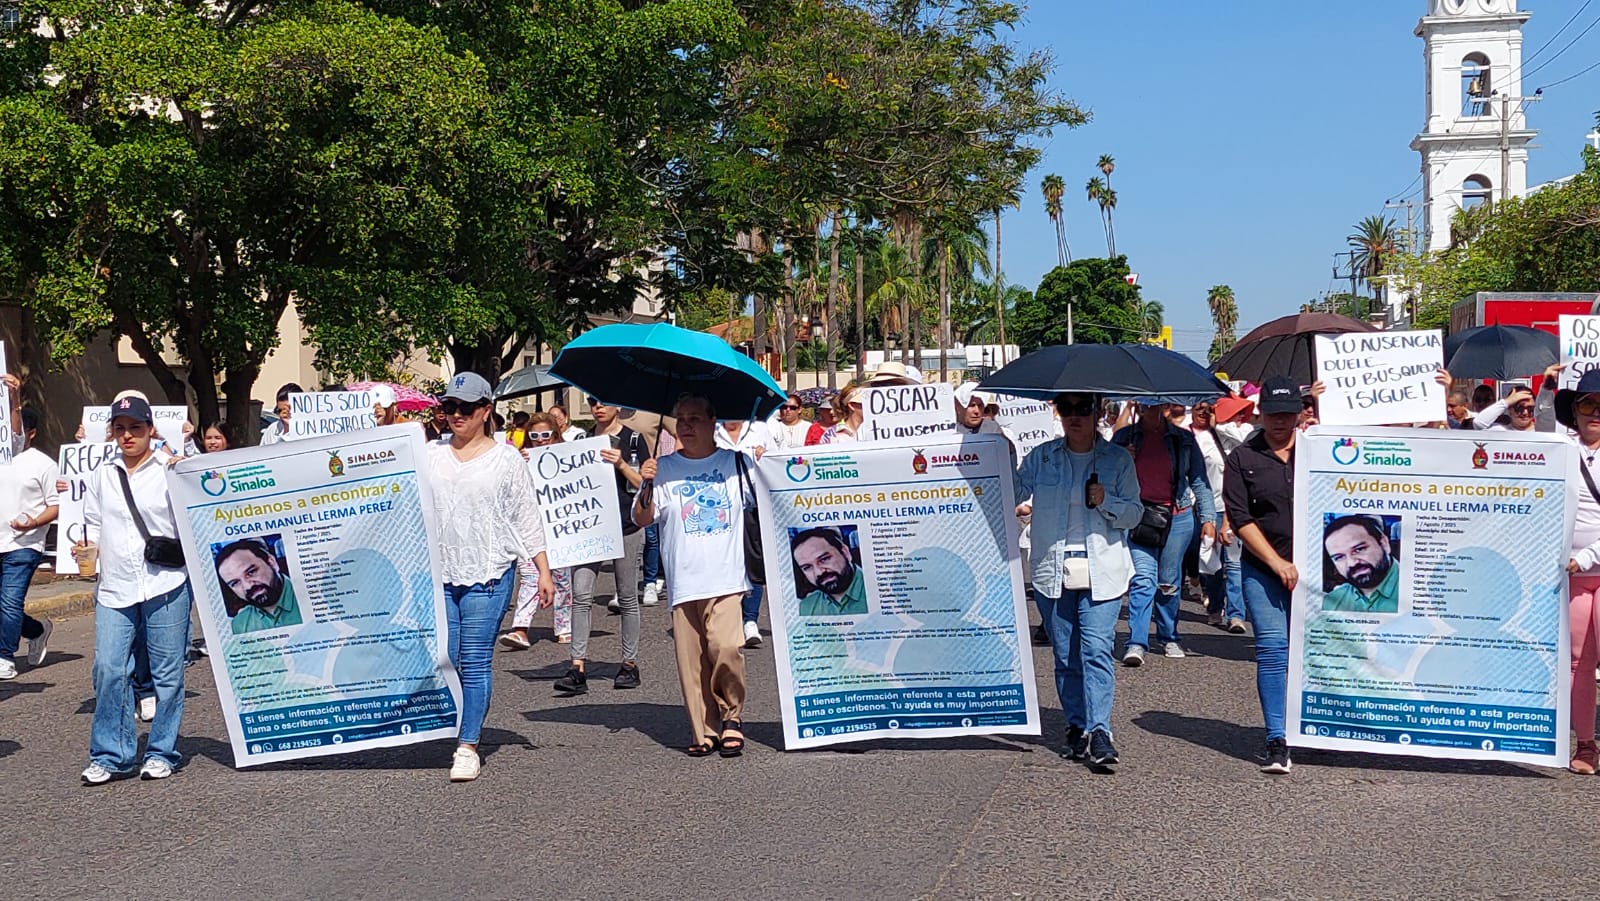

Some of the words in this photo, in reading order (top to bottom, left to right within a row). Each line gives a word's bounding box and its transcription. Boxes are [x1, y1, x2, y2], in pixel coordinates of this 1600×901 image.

[1331, 339, 1356, 355] TU
[1361, 334, 1441, 352] AUSENCIA
[1333, 375, 1357, 389] TU
[1362, 362, 1442, 386] BUSQUEDA
[292, 394, 313, 414] NO
[316, 394, 333, 413] ES
[338, 391, 371, 411] SOLO
[870, 386, 939, 415] OSCAR
[1009, 402, 1050, 417] FAMILIA
[89, 411, 112, 422] OS
[295, 419, 317, 436] UN
[872, 419, 891, 441] tu
[894, 420, 957, 438] ausencia
[347, 449, 396, 464] SINALOA
[931, 453, 979, 463] SINALOA
[1363, 453, 1412, 466] Sinaloa
[1493, 452, 1546, 461] SINALOA
[815, 467, 859, 480] Sinaloa
[230, 476, 276, 493] Sinaloa
[535, 475, 602, 506] MANUEL
[1335, 478, 1422, 495] Ayúdanos
[1428, 484, 1438, 494] a
[1443, 484, 1529, 498] encontrar
[1534, 487, 1544, 498] a
[214, 501, 293, 522] Ayúdanos
[297, 498, 307, 508] a
[310, 483, 387, 506] encontrar
[391, 482, 401, 493] a
[793, 492, 872, 510] Ayúdanos
[877, 492, 886, 502] a
[891, 486, 969, 501] encontrar
[974, 486, 984, 496] a
[1343, 498, 1384, 509] OSCAR
[1388, 500, 1443, 512] MANUEL
[1446, 502, 1489, 513] LERMA
[1493, 503, 1532, 515] PEREZ
[224, 522, 263, 536] OSCAR
[264, 513, 316, 530] MANUEL
[318, 506, 357, 521] LERMA
[359, 500, 394, 516] PEREZ
[545, 497, 604, 524] LERMA
[802, 511, 840, 523] OSCAR
[843, 508, 893, 520] MANUEL
[895, 505, 936, 517] LERMA
[938, 502, 974, 514] PEREZ
[552, 514, 603, 539] PÉREZ
[800, 699, 809, 708] Si
[812, 696, 841, 706] tienes
[844, 691, 899, 703] información
[902, 690, 943, 698] referente
[956, 690, 976, 698] esta
[800, 707, 826, 718] llama
[890, 702, 902, 710] Tu
[904, 701, 932, 710] ayuda
[946, 701, 967, 710] muy
[969, 698, 1022, 710] importante.
[1306, 695, 1317, 704] Si
[1321, 697, 1351, 708] tienes
[1355, 700, 1415, 713] información
[1420, 705, 1466, 716] referente
[1480, 708, 1502, 718] esta
[244, 716, 255, 725] Si
[257, 712, 285, 723] tienes
[288, 704, 341, 718] información
[343, 700, 382, 711] referente
[390, 698, 408, 707] esta
[1306, 706, 1333, 717] llama
[1405, 714, 1418, 723] Tu
[1420, 716, 1451, 728] ayuda
[1453, 718, 1465, 727] es
[1468, 719, 1491, 730] muy
[1493, 719, 1553, 733] importante.
[247, 725, 272, 735] llama
[333, 715, 345, 724] Tu
[346, 711, 372, 722] ayuda
[383, 709, 402, 719] muy
[831, 726, 845, 734] 668
[846, 722, 877, 732] 2194525
[278, 741, 291, 750] 668
[292, 738, 322, 749] 2194525
[1335, 729, 1351, 738] 668
[1352, 731, 1386, 742] 2194525
